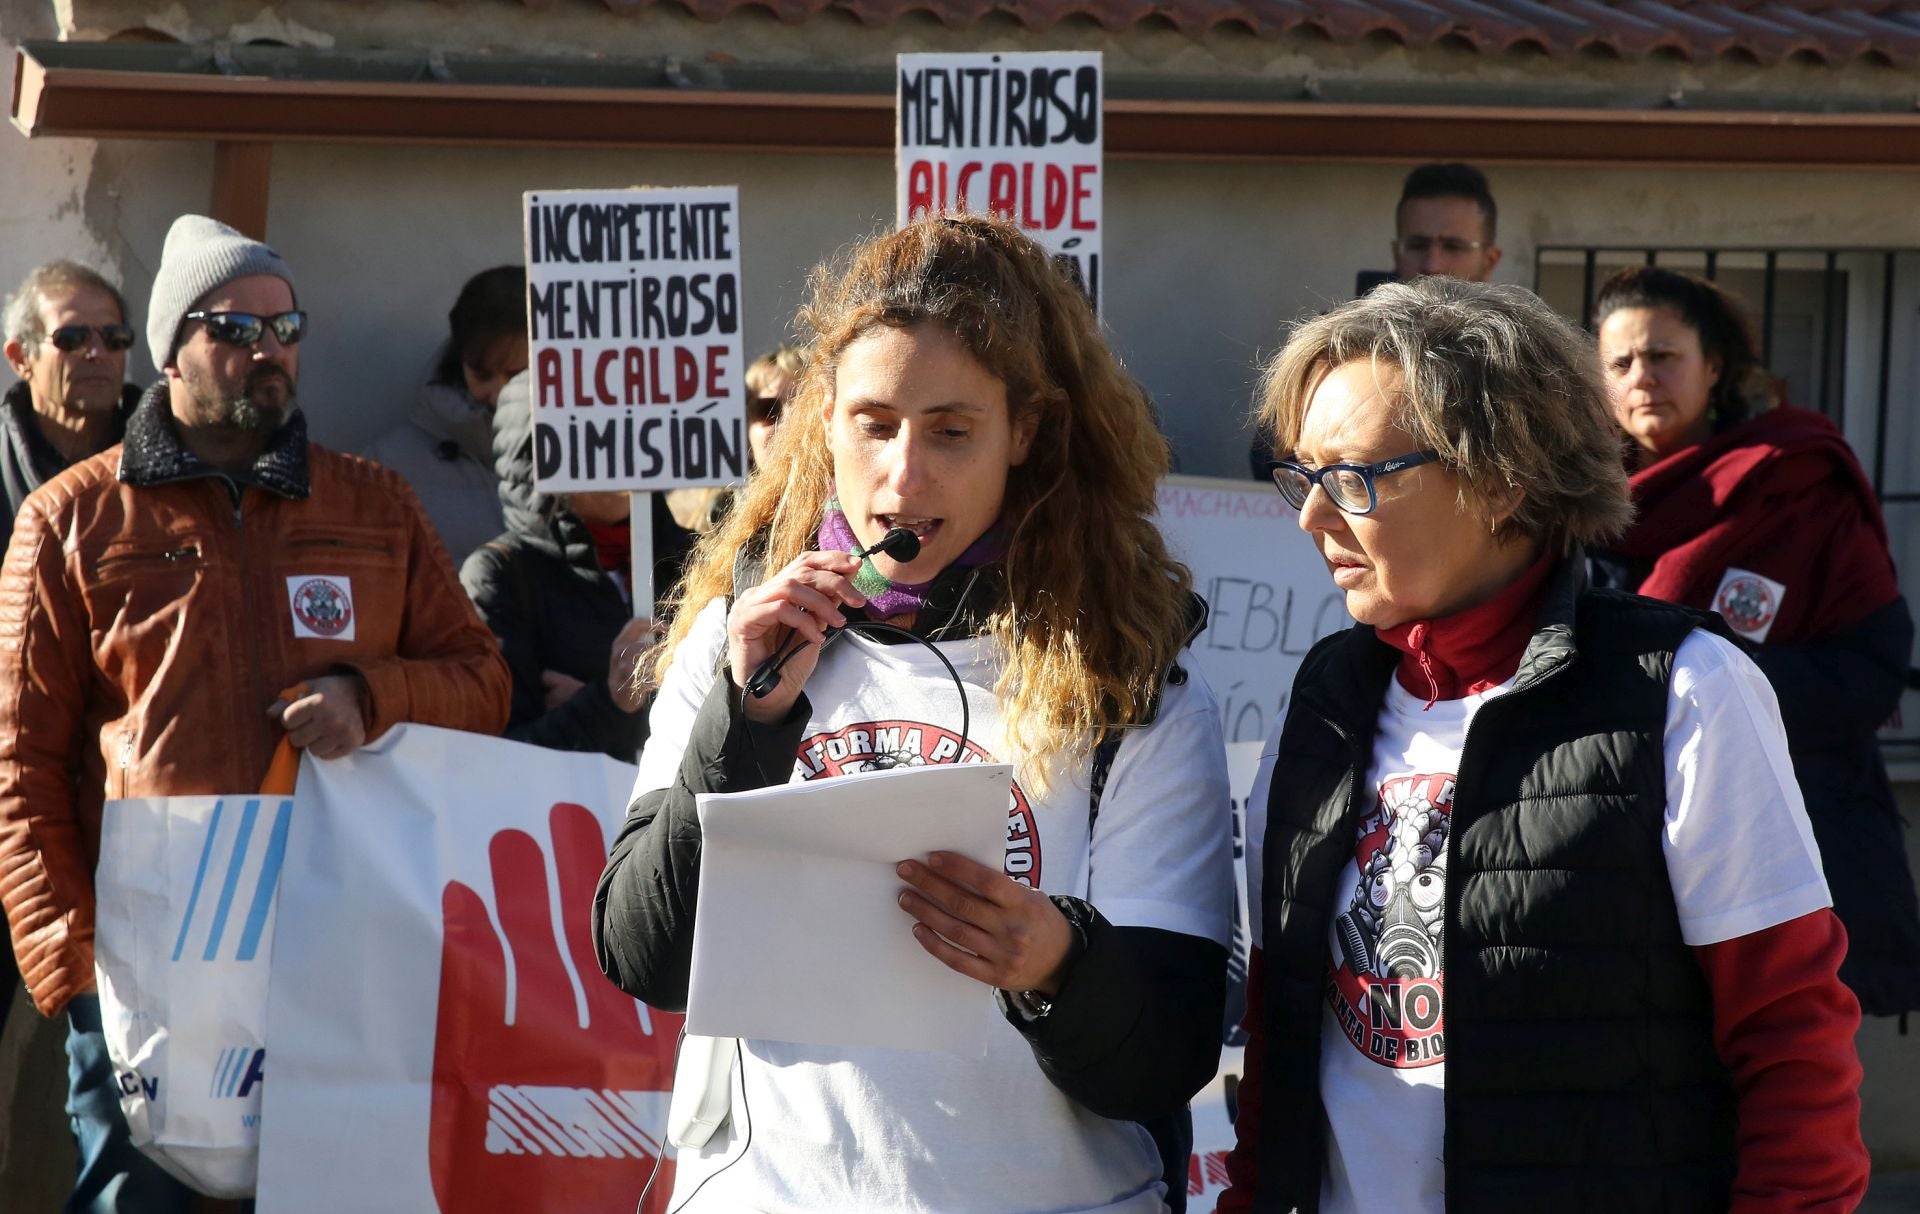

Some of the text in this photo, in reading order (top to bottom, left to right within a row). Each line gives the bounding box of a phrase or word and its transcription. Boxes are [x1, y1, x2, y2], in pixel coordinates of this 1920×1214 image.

[902, 55, 1097, 148] MENTIROSO
[531, 195, 731, 263] INCOMPETENTE
[530, 268, 737, 340] MENTIROSO
[538, 346, 730, 408] ALCALDE
[535, 401, 742, 480] DIMISIÓN
[1369, 983, 1442, 1031] NO
[1369, 1031, 1400, 1063] DE
